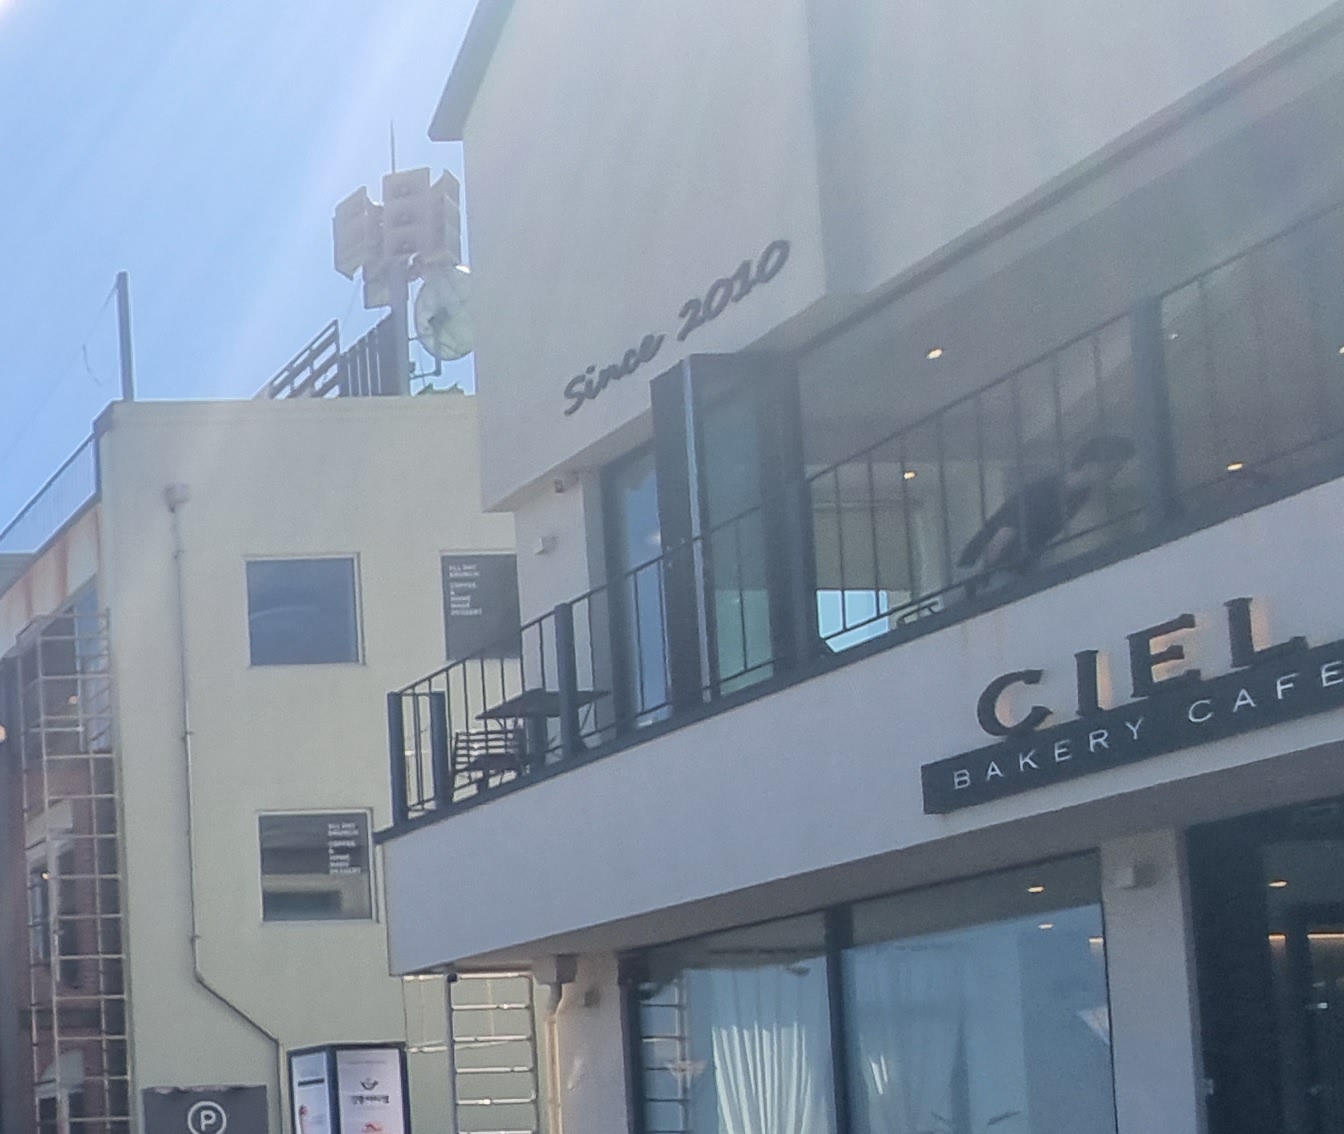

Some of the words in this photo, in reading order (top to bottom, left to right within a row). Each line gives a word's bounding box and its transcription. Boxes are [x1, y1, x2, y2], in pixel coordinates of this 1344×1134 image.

[564, 333, 666, 416] Since
[677, 239, 790, 342] 2010
[953, 718, 1144, 790] BAKERY
[1188, 660, 1344, 724] CAFE
[977, 597, 1307, 737] CIEL
[200, 1110, 217, 1131] P
